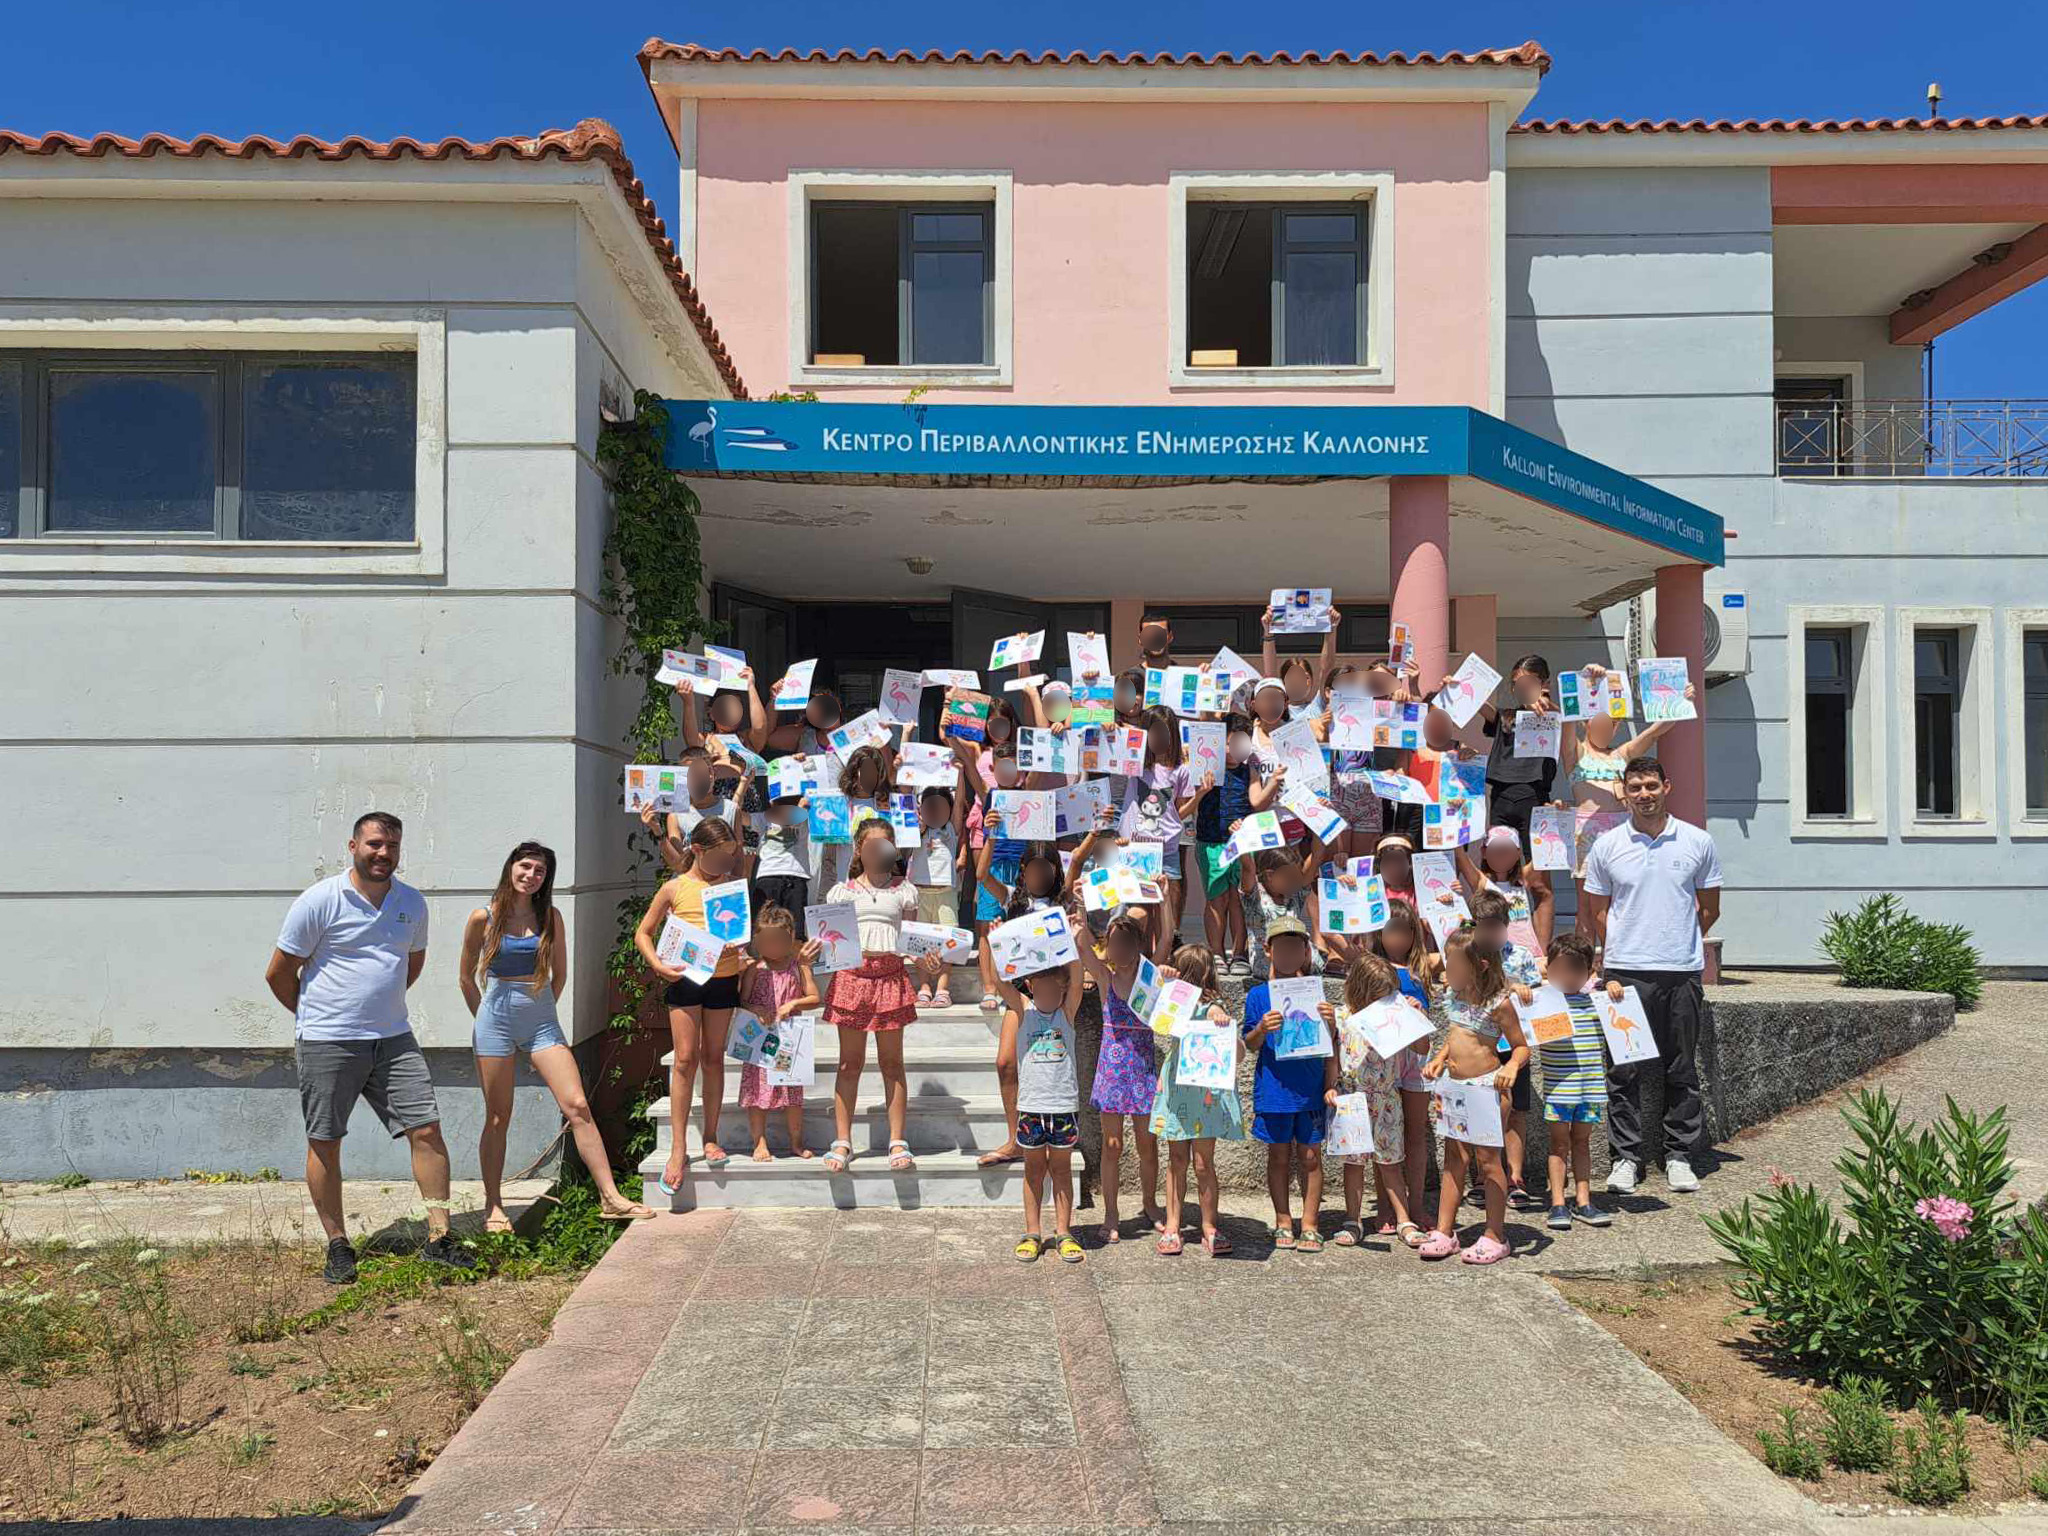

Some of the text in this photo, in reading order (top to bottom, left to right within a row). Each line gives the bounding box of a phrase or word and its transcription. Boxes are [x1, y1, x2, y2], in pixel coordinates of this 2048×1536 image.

[822, 428, 1430, 455] ΚΕΝΤΡΟ ΠΕΡΙΒΑΛΛΟΝΤΙΚΗΣ ΕΝΗΜΕΡΩΣΗΣ ΚΑΛΛΟΝΗΣ
[1502, 445, 1705, 545] KALLONI ENVIRONMENTAL INFORMATION CENTER
